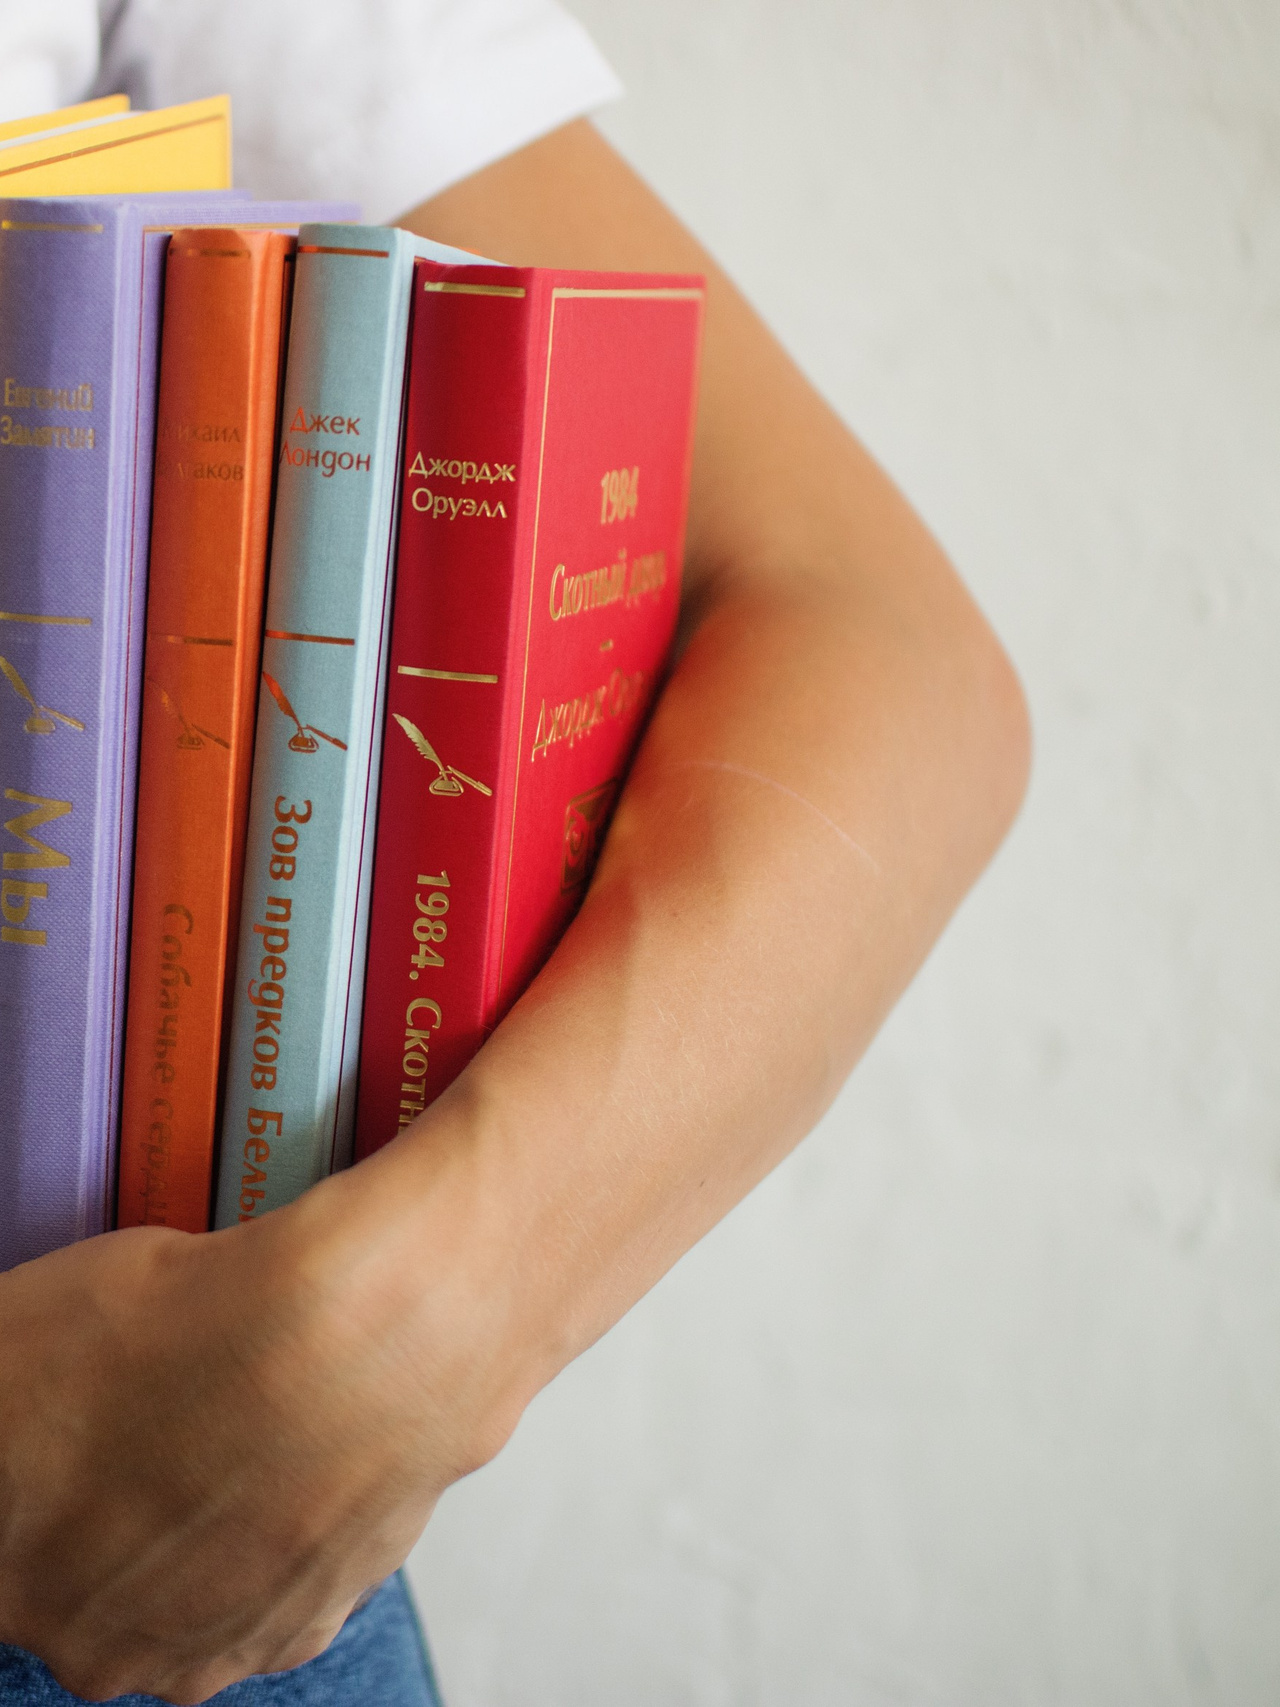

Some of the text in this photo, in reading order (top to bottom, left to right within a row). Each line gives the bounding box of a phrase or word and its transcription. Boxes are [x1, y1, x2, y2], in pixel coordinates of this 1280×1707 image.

[163, 422, 242, 443] ихаил
[289, 406, 361, 436] Джек
[280, 440, 372, 478] Лондон
[408, 451, 517, 484] Джордж
[411, 487, 508, 520] Оруэлл
[599, 465, 640, 525] 1984
[549, 548, 627, 621] Скотный
[0, 788, 73, 947] Мы
[238, 795, 313, 1223] Зов предков Белы
[398, 870, 451, 1134] 1984. Скотн
[138, 903, 194, 1227] Собачье сердц
